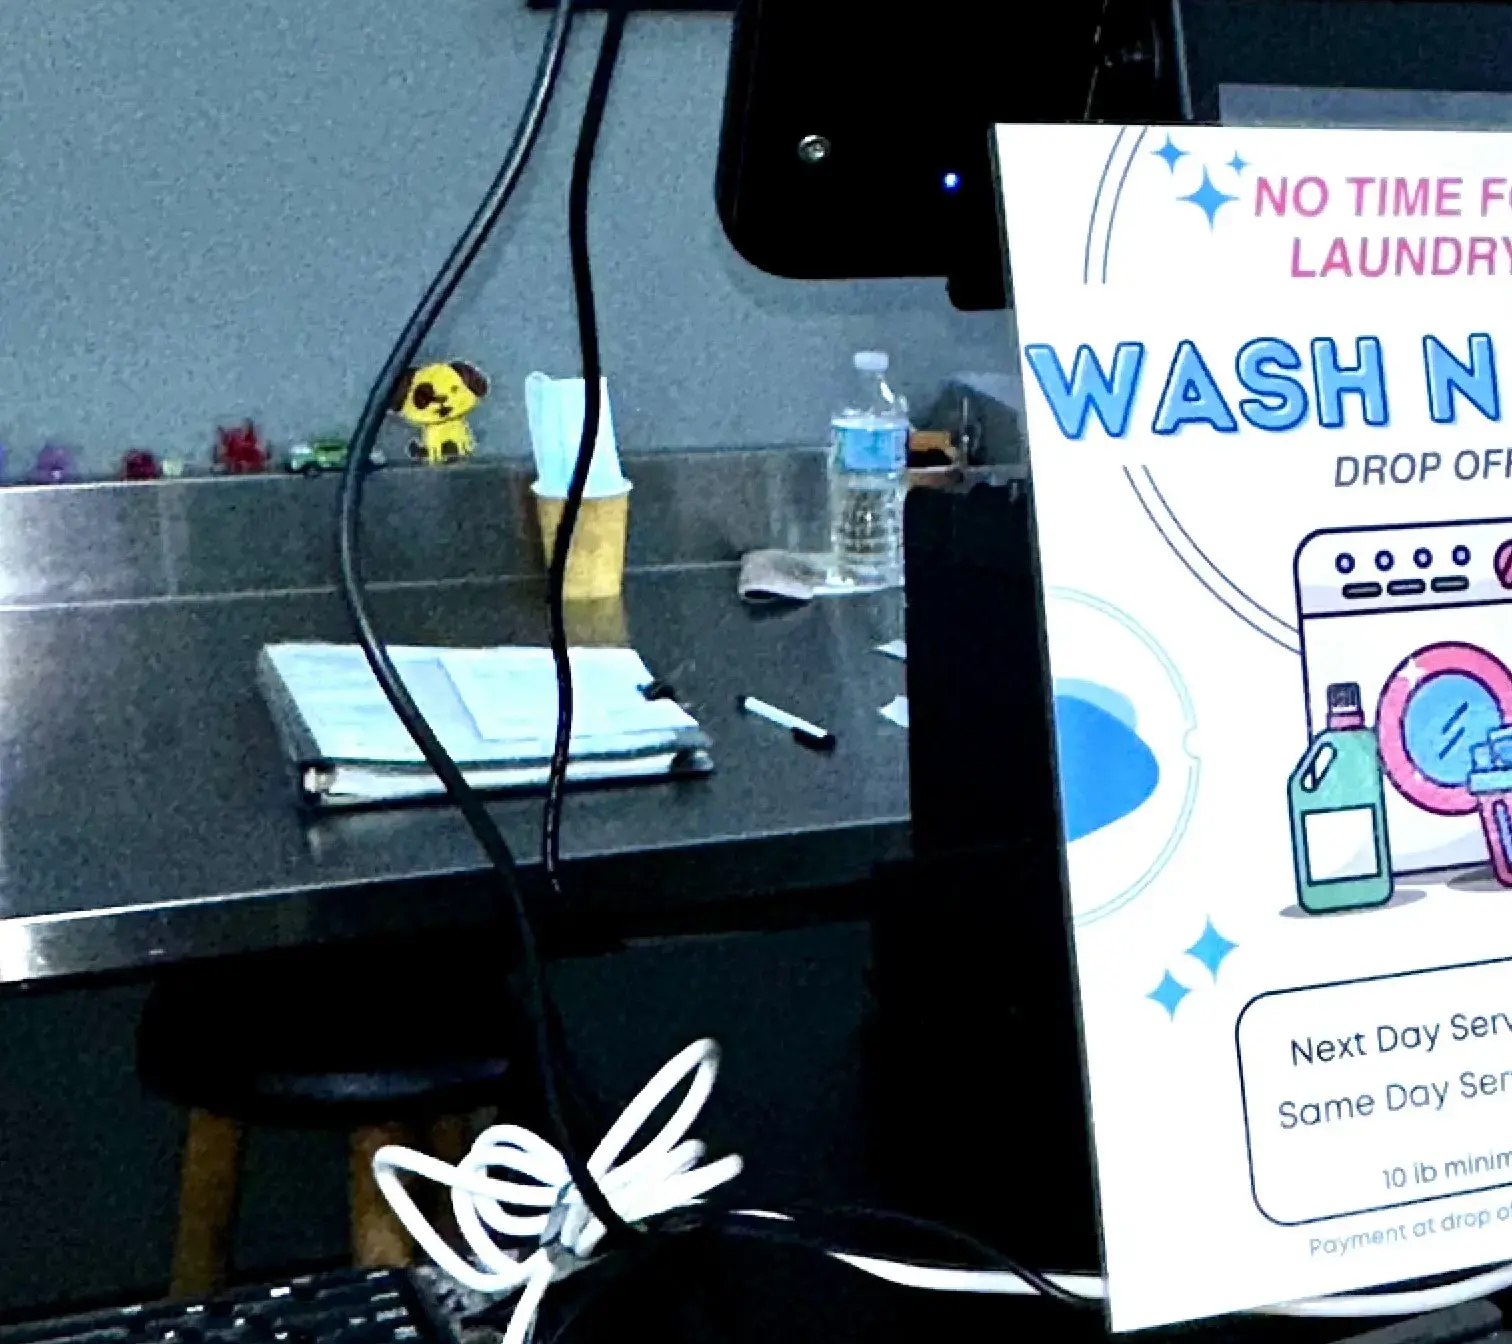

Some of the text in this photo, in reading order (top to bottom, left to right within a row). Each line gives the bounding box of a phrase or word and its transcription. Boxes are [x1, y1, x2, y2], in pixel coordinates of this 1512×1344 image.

[1254, 176, 1330, 217] NO
[1345, 176, 1464, 217] TIME
[1024, 336, 1391, 440] WASH
[1422, 331, 1501, 424] N
[1334, 451, 1442, 488] DROP
[1291, 1032, 1367, 1067] Next
[1376, 1022, 1441, 1053] Day
[1278, 1094, 1375, 1129] Same
[1386, 1080, 1449, 1111] Day
[1382, 1166, 1407, 1189] 10
[1414, 1161, 1438, 1184] lb
[1309, 1224, 1407, 1256] Payment
[1412, 1218, 1436, 1238] at
[1441, 1208, 1491, 1233] drop
